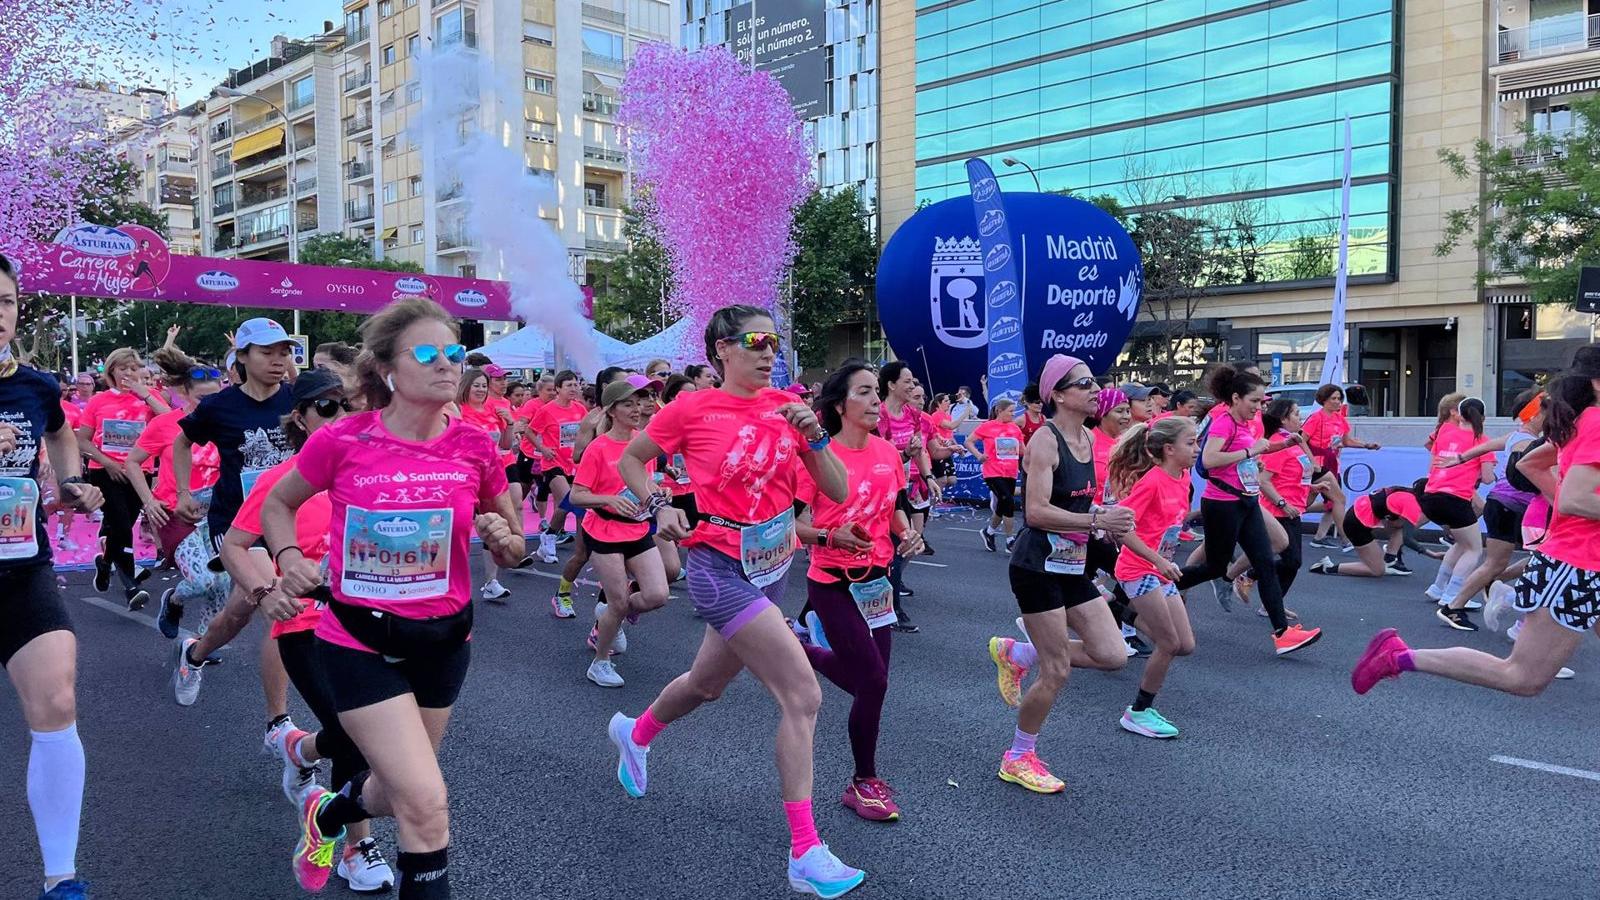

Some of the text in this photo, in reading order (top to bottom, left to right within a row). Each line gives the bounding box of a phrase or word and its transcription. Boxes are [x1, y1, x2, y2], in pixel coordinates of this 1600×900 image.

[737, 20, 746, 32] El
[755, 16, 766, 27] es
[757, 29, 769, 41] un
[771, 17, 810, 37] número.
[756, 43, 766, 55] el
[767, 33, 804, 52] número
[805, 29, 815, 41] 2.
[1046, 234, 1118, 260] Madrid
[59, 250, 119, 271] Carrera
[1078, 264, 1099, 281] es
[74, 270, 85, 281] de
[92, 268, 140, 296] Mujer
[326, 283, 365, 296] OYSHO
[270, 286, 303, 298] Santander
[1047, 284, 1116, 310] Deporte
[1073, 310, 1094, 328] es
[1041, 329, 1108, 352] Respeto
[353, 471, 469, 488] Sports Santander
[378, 549, 417, 565] 016
[764, 542, 785, 561] 016
[353, 583, 387, 595] OYSHO
